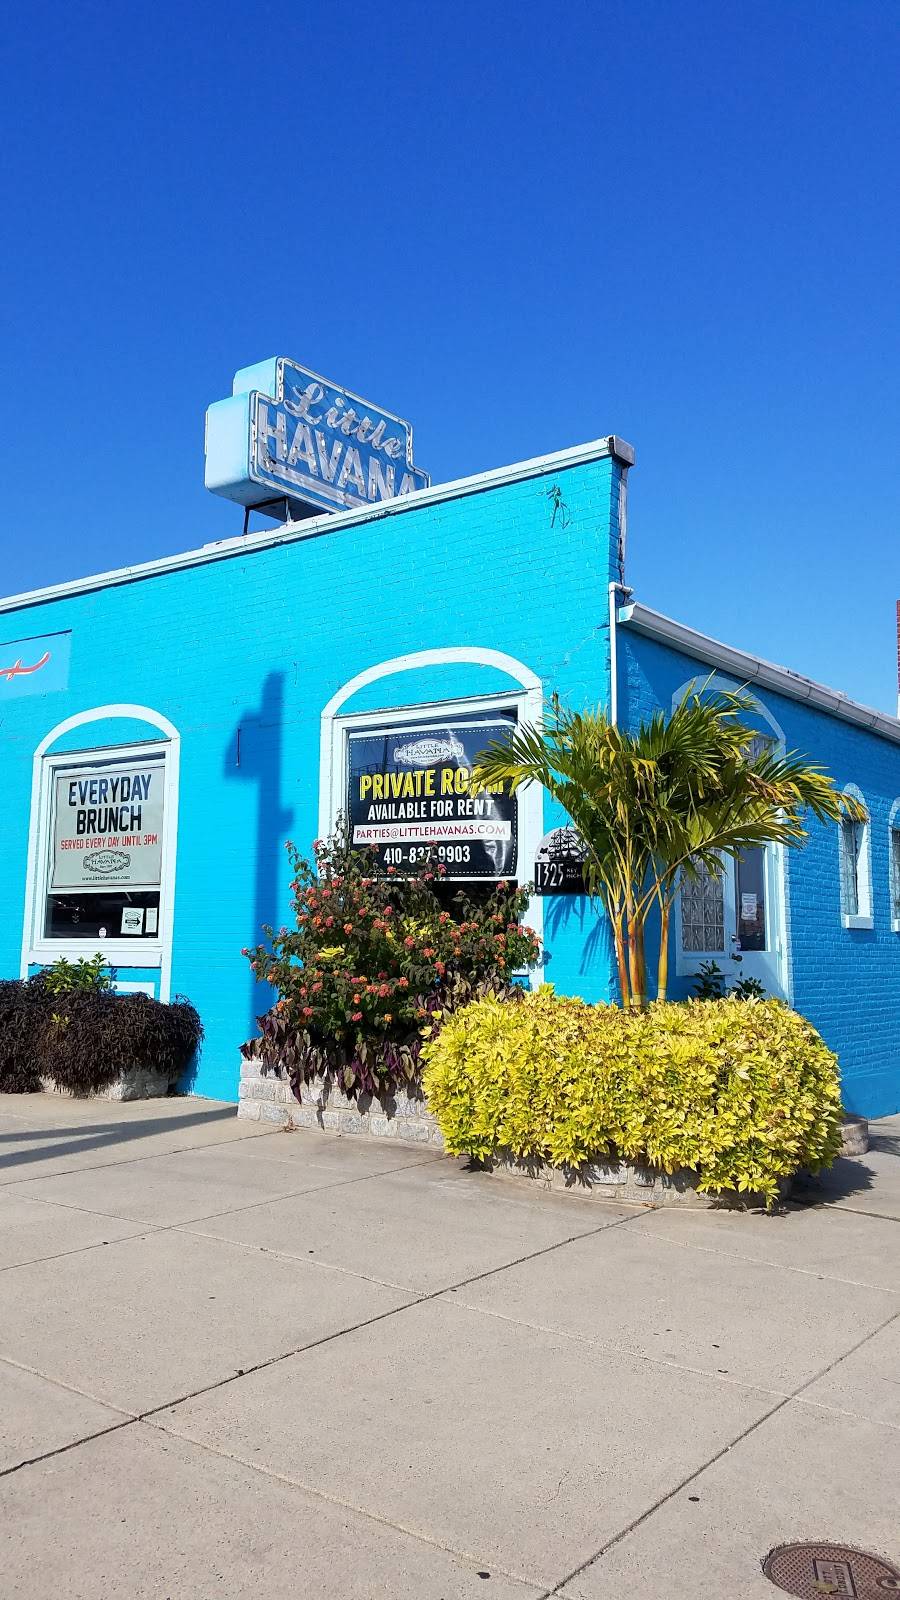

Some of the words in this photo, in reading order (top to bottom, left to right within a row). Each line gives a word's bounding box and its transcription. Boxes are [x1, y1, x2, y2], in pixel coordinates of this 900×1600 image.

[283, 382, 403, 459] Little
[257, 404, 416, 502] HAVANA
[405, 747, 450, 757] HAVANA
[68, 774, 152, 807] EVERYDAY
[359, 769, 436, 801] PRIVATE
[440, 767, 504, 796] RO
[76, 805, 142, 835] BRUNCH
[367, 800, 427, 821] AVAILABLE
[430, 799, 453, 817] FOR
[457, 799, 495, 816] RENT
[60, 839, 84, 851] SERVED
[85, 837, 107, 848] EVERY
[107, 835, 121, 847] DAY
[122, 834, 142, 846] UNTIL
[143, 833, 158, 845] 3PM
[355, 824, 506, 839] PARTIES@LITTLEHAVANAS.COM
[537, 863, 564, 887] 1325
